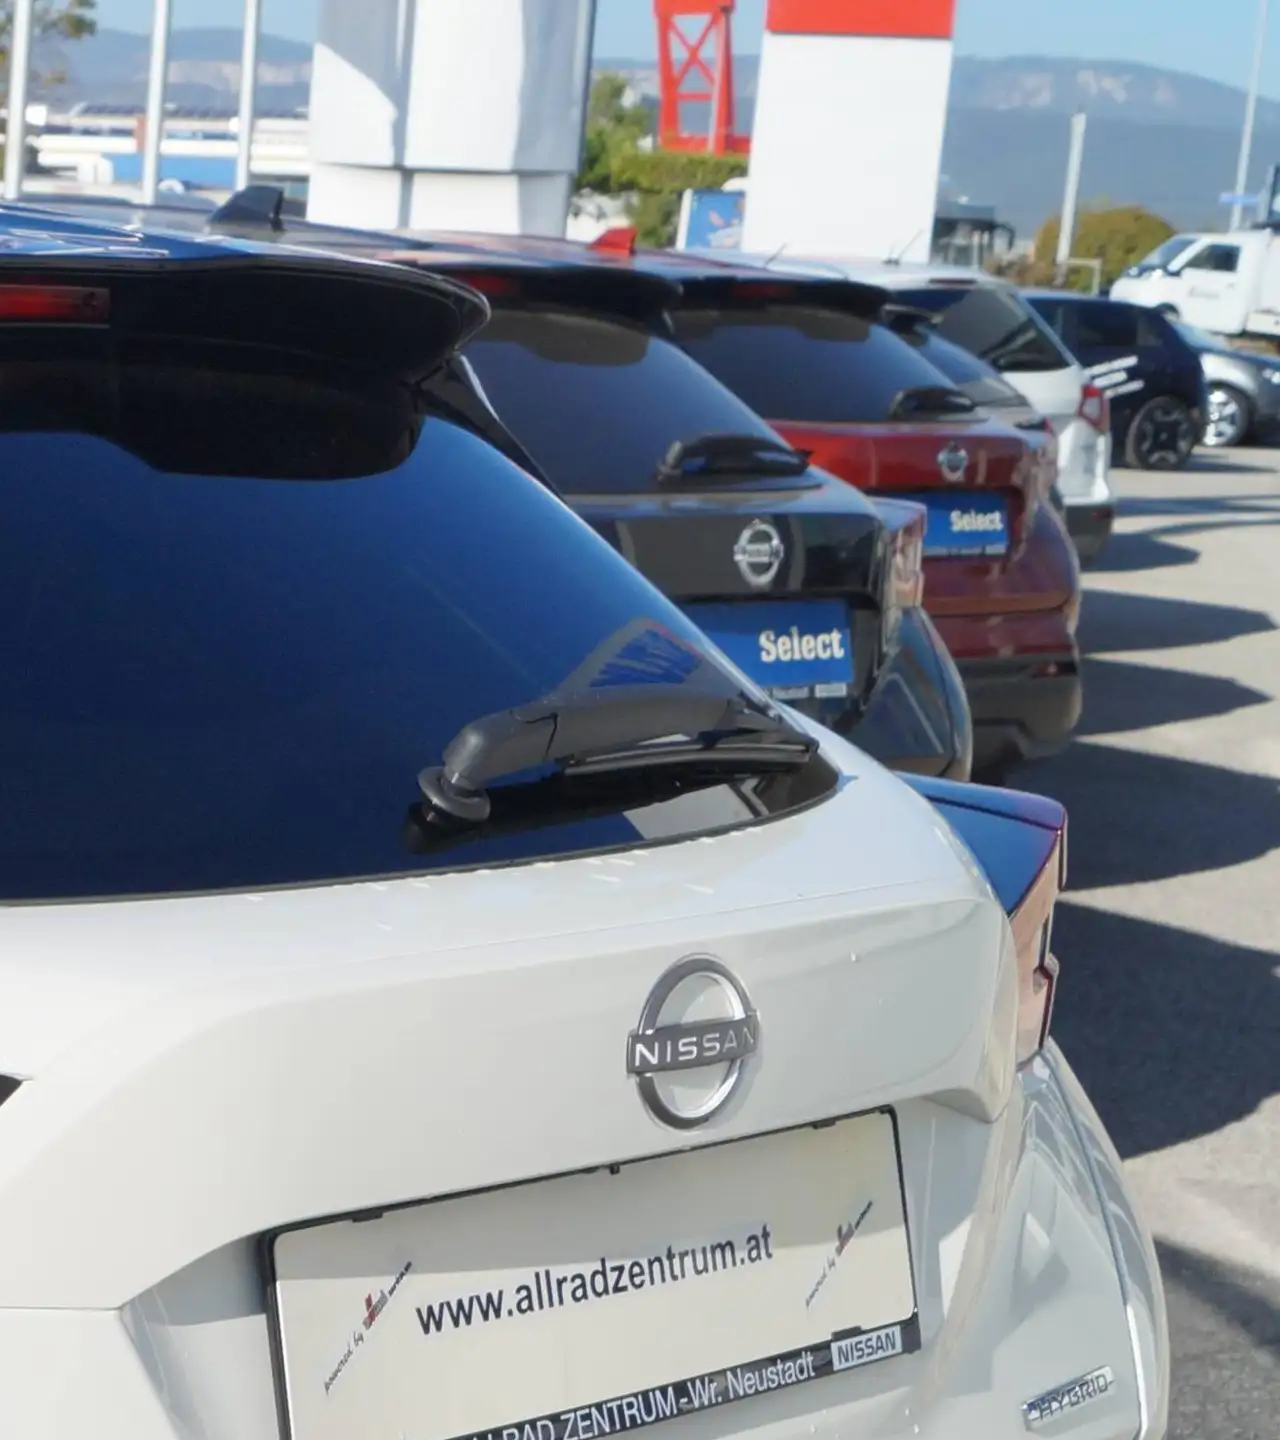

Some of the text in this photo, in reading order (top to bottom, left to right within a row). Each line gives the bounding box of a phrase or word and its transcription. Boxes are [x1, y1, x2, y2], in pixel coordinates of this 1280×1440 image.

[949, 508, 1003, 533] Select
[759, 625, 845, 663] Select
[634, 1024, 756, 1067] NISSAN
[415, 1223, 774, 1335] www.allradzentrum.at
[836, 1331, 898, 1365] NISSAN
[725, 1350, 816, 1399] Neustadt
[1037, 1373, 1109, 1421] HYBRID
